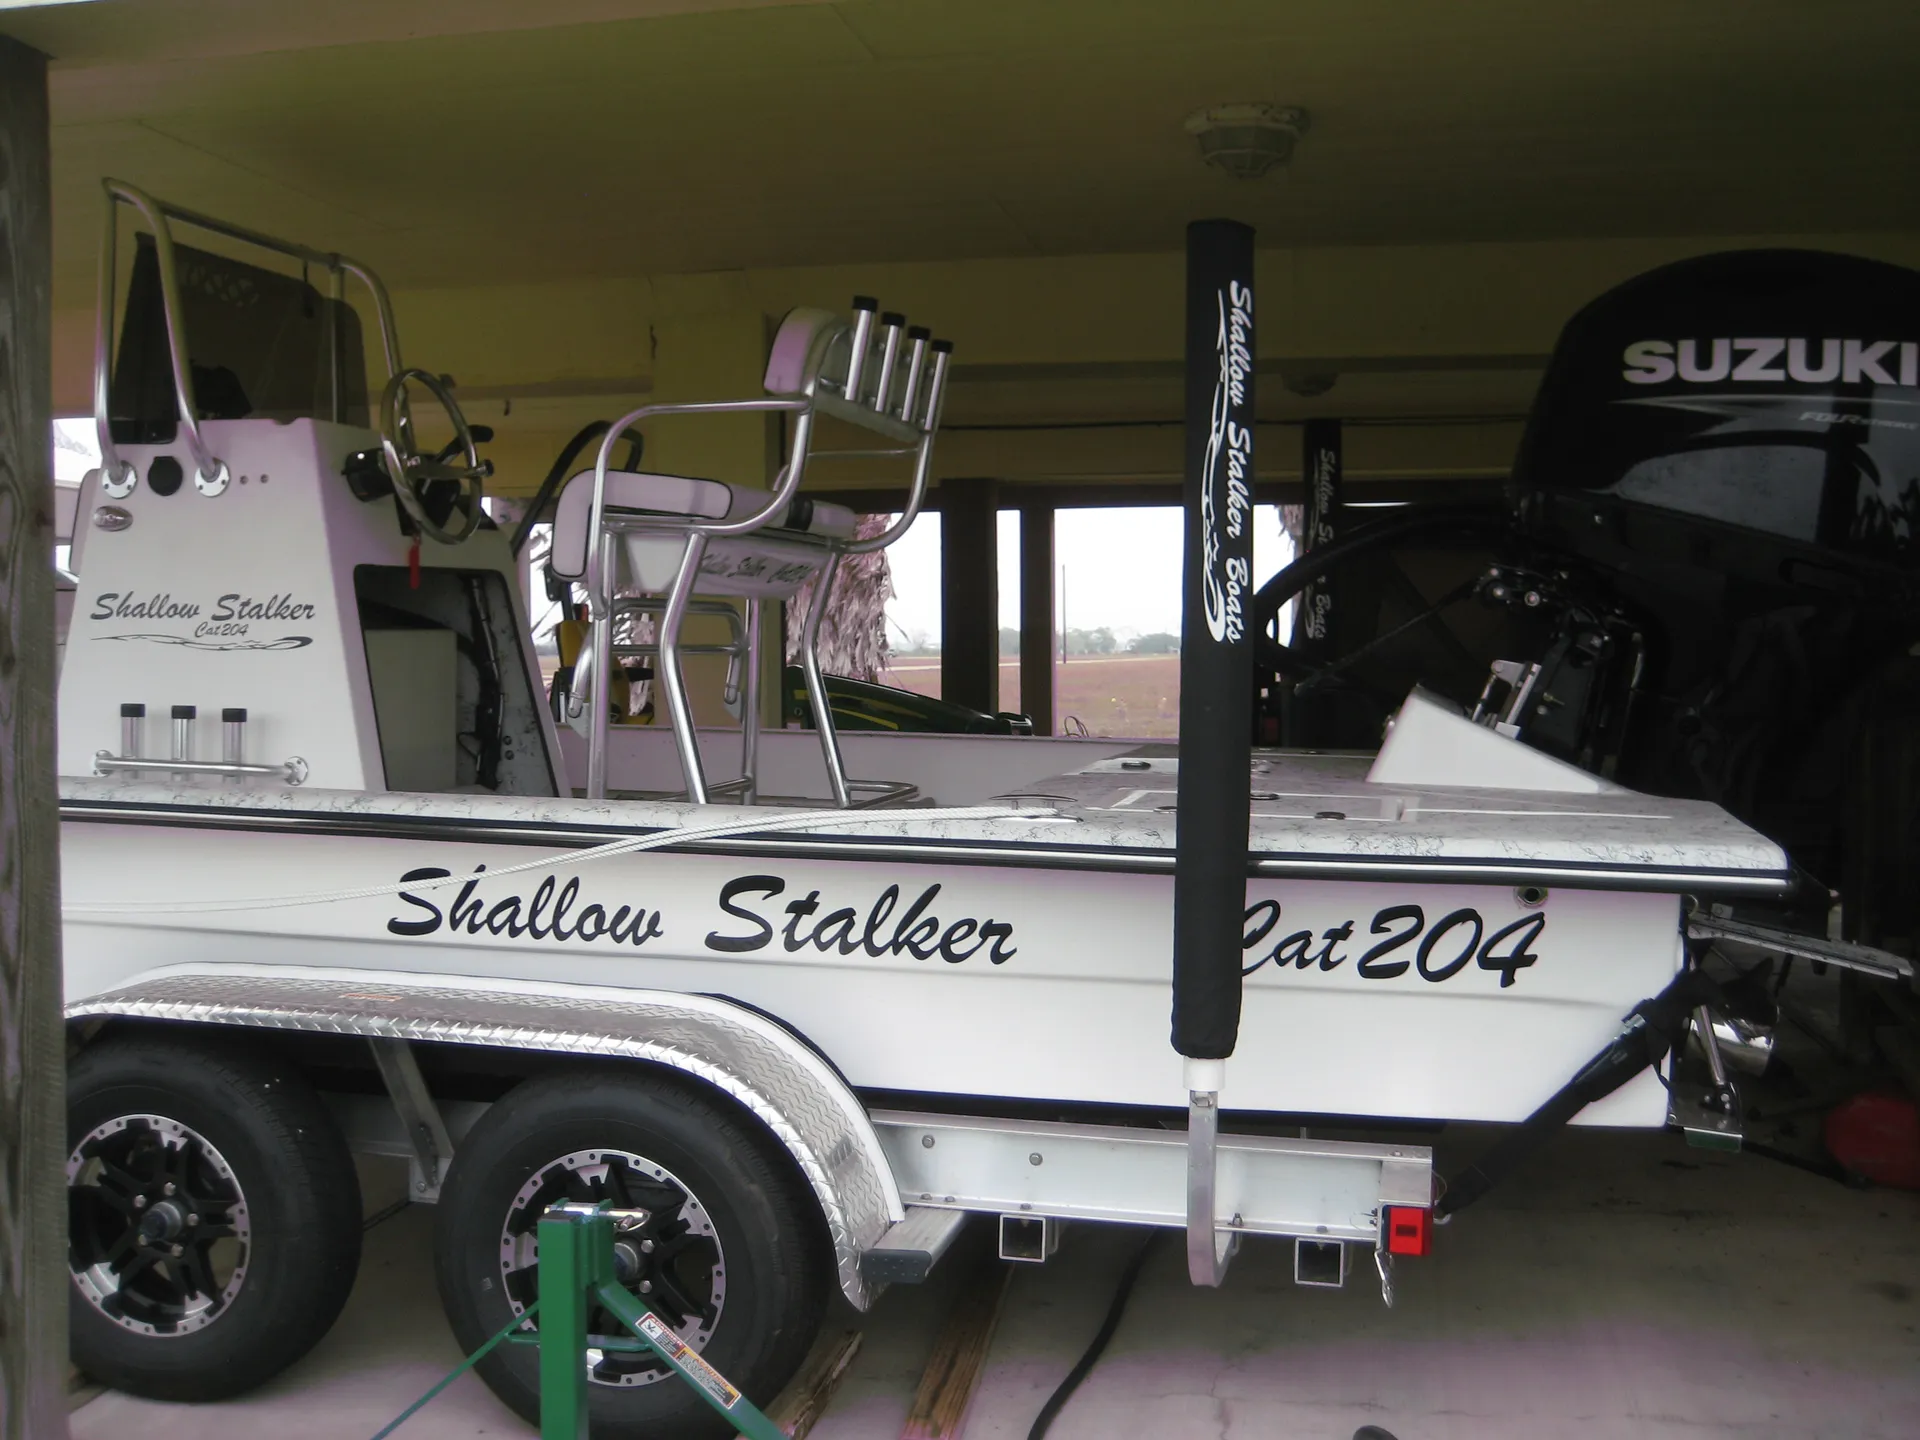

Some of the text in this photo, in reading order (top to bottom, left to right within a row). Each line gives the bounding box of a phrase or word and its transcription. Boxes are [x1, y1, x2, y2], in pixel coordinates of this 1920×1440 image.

[1622, 338, 1918, 386] SUZUKI
[1226, 280, 1252, 644] Shallow Stalker Boats
[1319, 448, 1335, 515] Shallow
[90, 591, 315, 621] Shallow Stalker
[195, 621, 249, 638] Cat204
[387, 864, 1018, 965] Shallow Stalker
